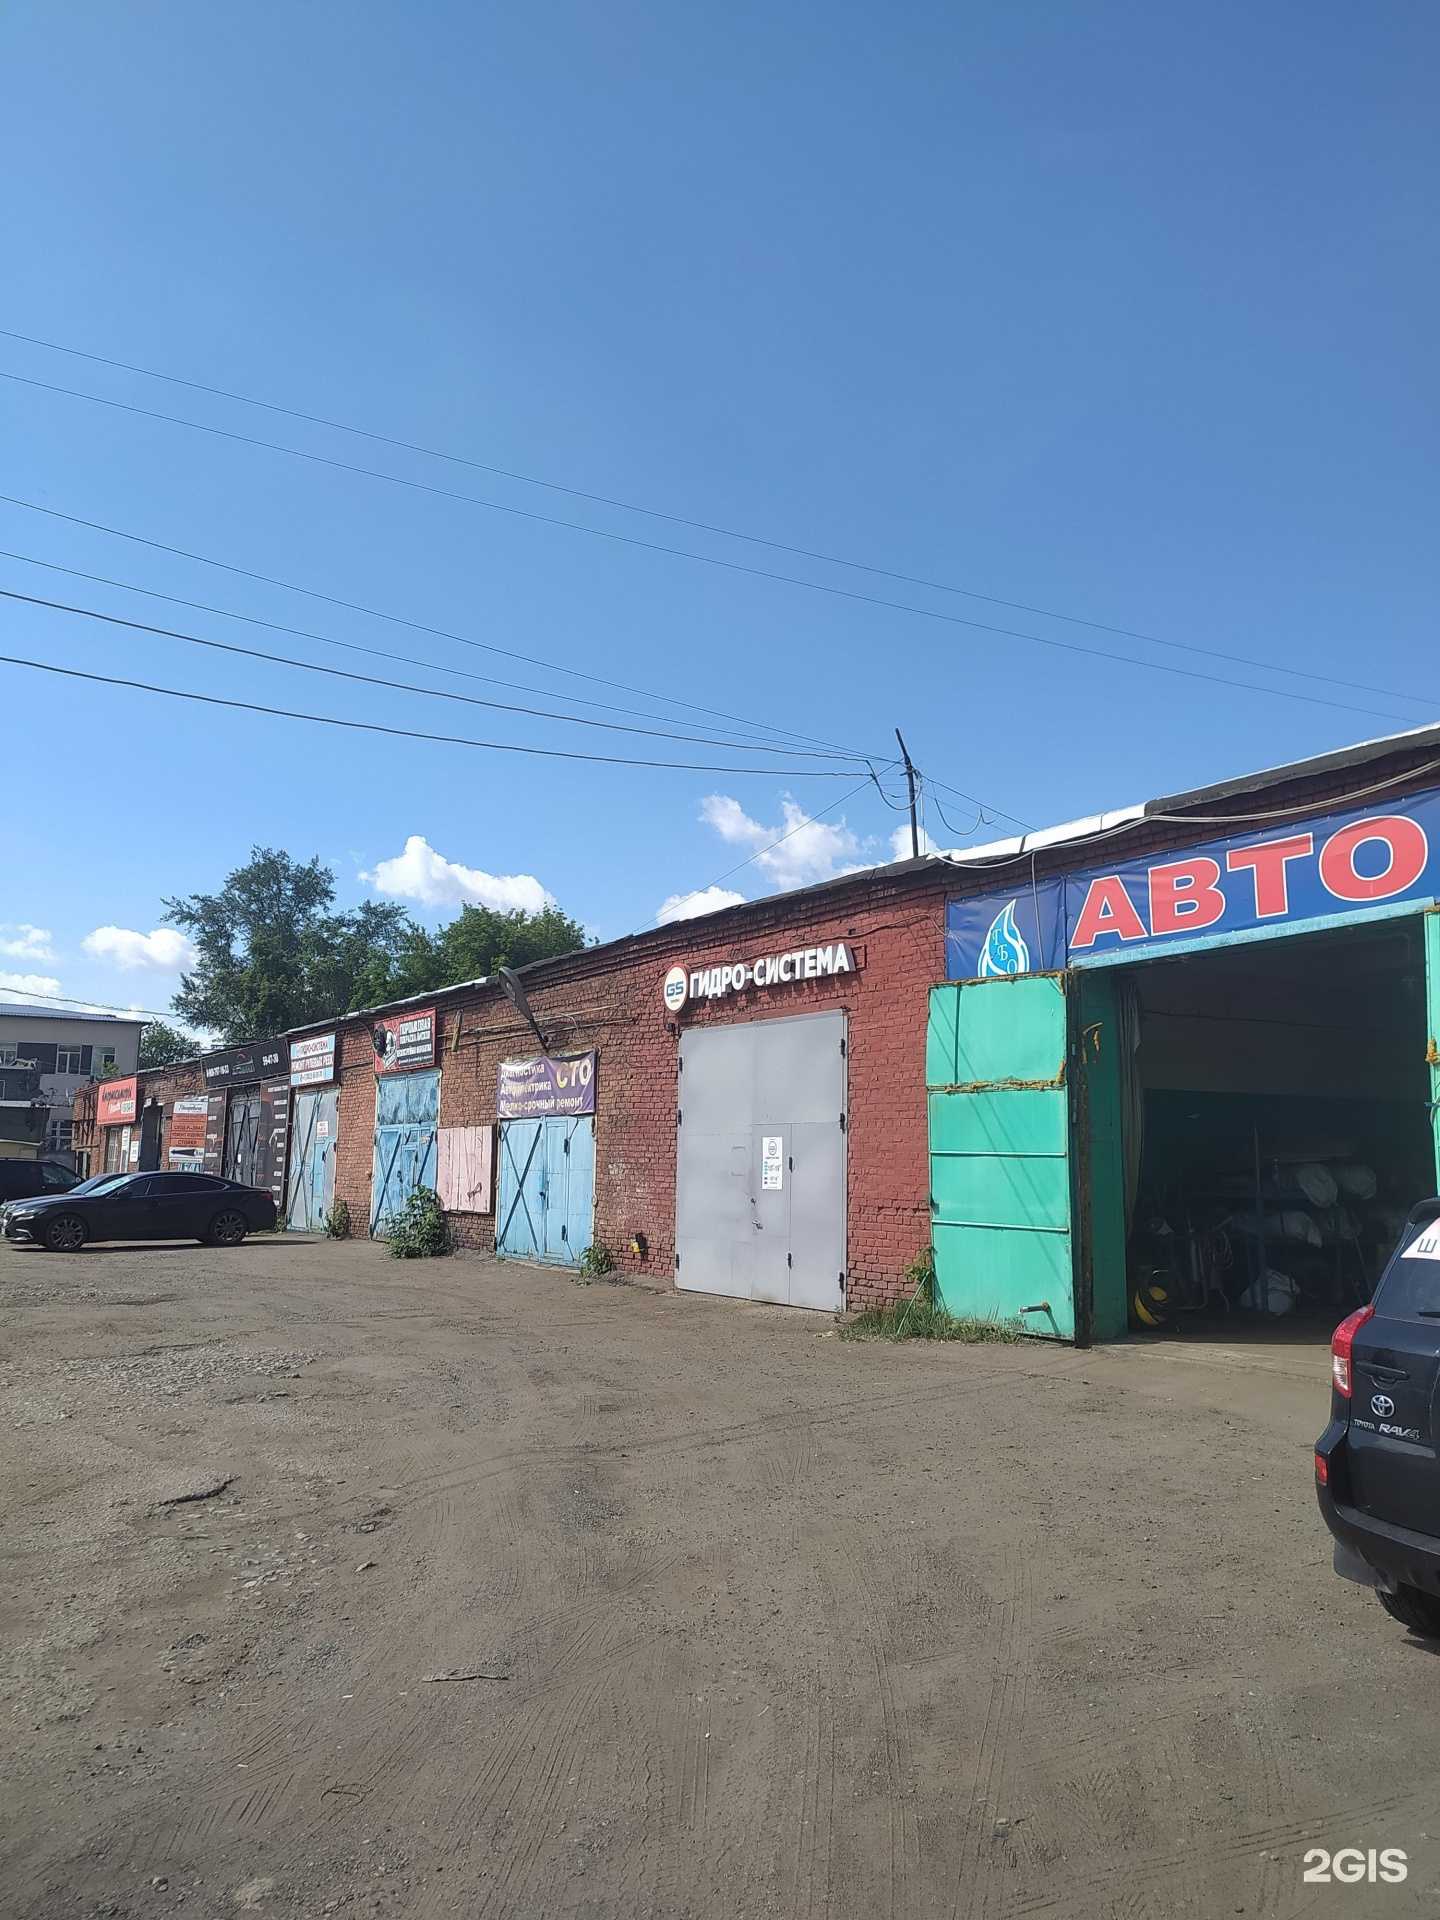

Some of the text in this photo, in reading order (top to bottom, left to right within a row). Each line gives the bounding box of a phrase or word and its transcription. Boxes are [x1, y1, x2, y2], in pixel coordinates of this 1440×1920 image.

[1069, 815, 1428, 948] АВТО
[689, 943, 852, 999] ГИДРО-СИСТЕМА
[666, 981, 684, 997] GS
[556, 1061, 591, 1088] СТО
[556, 1096, 584, 1111] ремонт
[1354, 1419, 1420, 1441] TOYOTA RAV4
